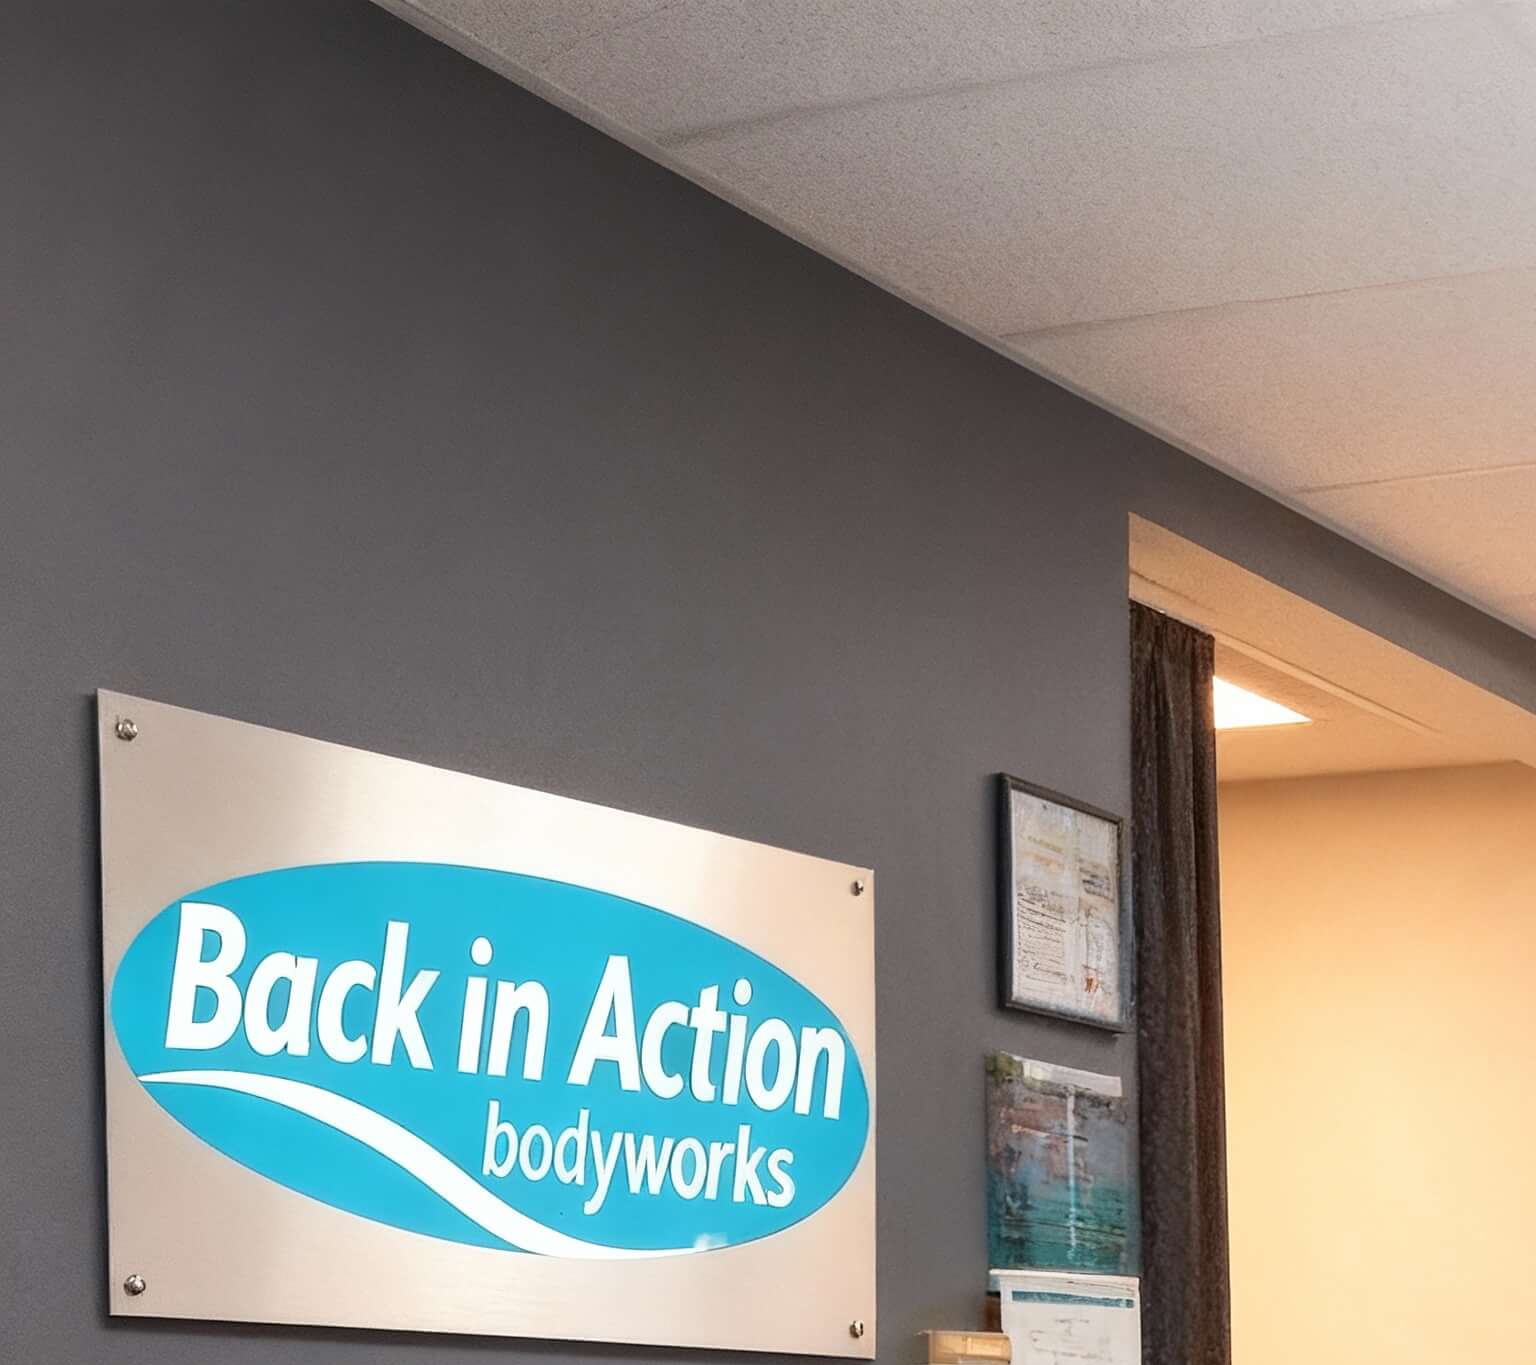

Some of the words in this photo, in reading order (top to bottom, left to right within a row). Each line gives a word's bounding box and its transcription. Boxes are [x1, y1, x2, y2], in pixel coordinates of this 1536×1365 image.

[165, 901, 440, 1070] Back
[457, 936, 550, 1082] in
[567, 955, 847, 1120] Action
[482, 1100, 796, 1216] bodyworks
